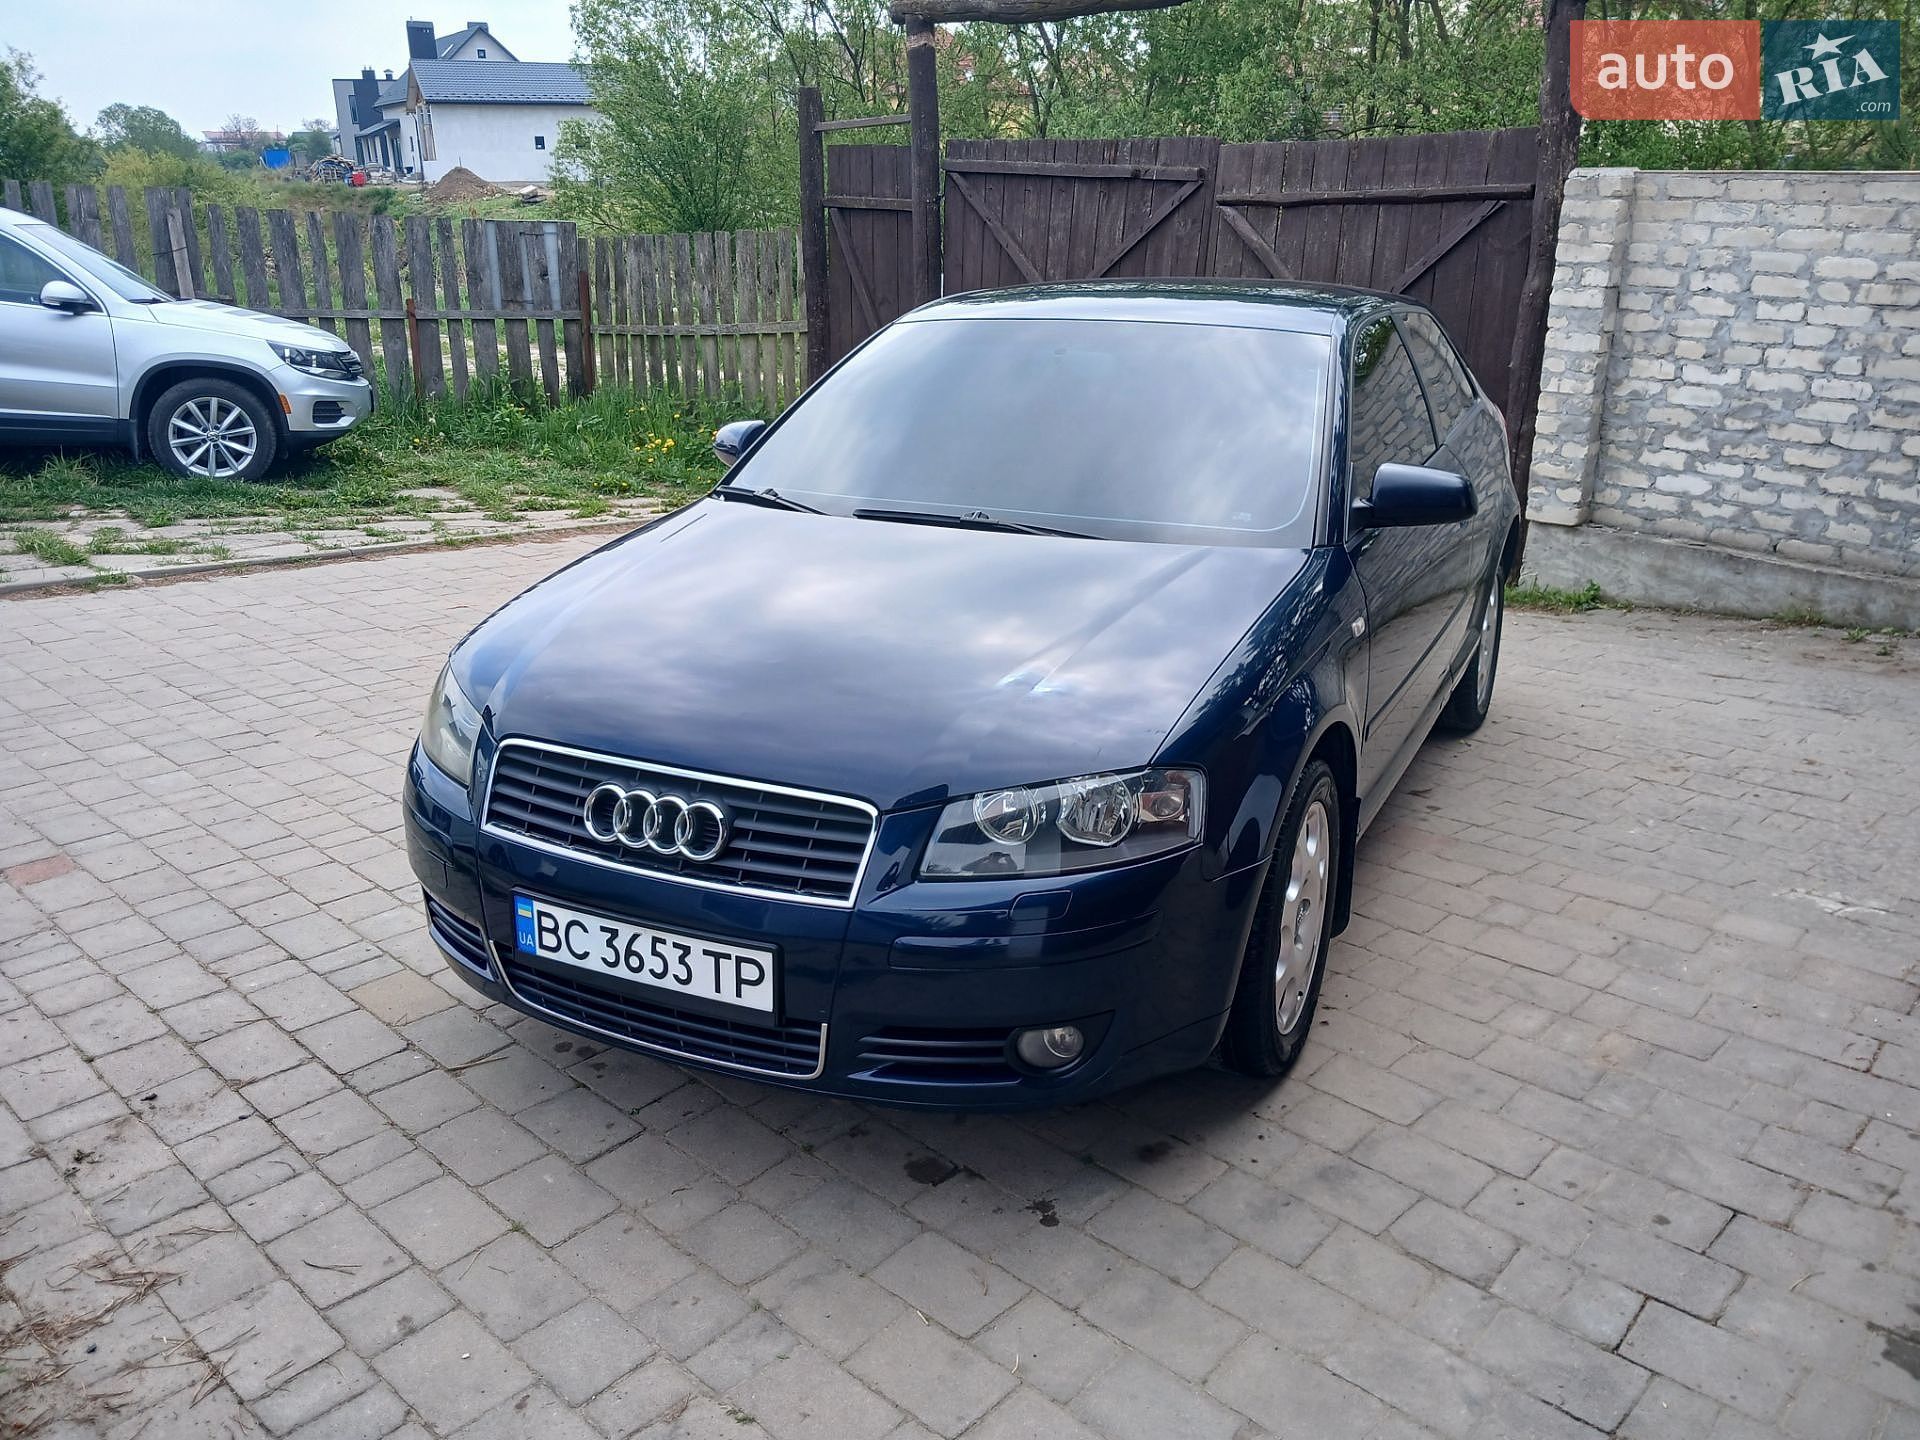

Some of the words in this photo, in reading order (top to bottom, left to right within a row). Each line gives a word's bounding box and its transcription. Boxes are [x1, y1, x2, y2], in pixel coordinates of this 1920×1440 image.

[518, 931, 535, 946] UA
[537, 909, 590, 961] BC
[600, 925, 693, 986] 3653
[702, 949, 766, 999] TP
